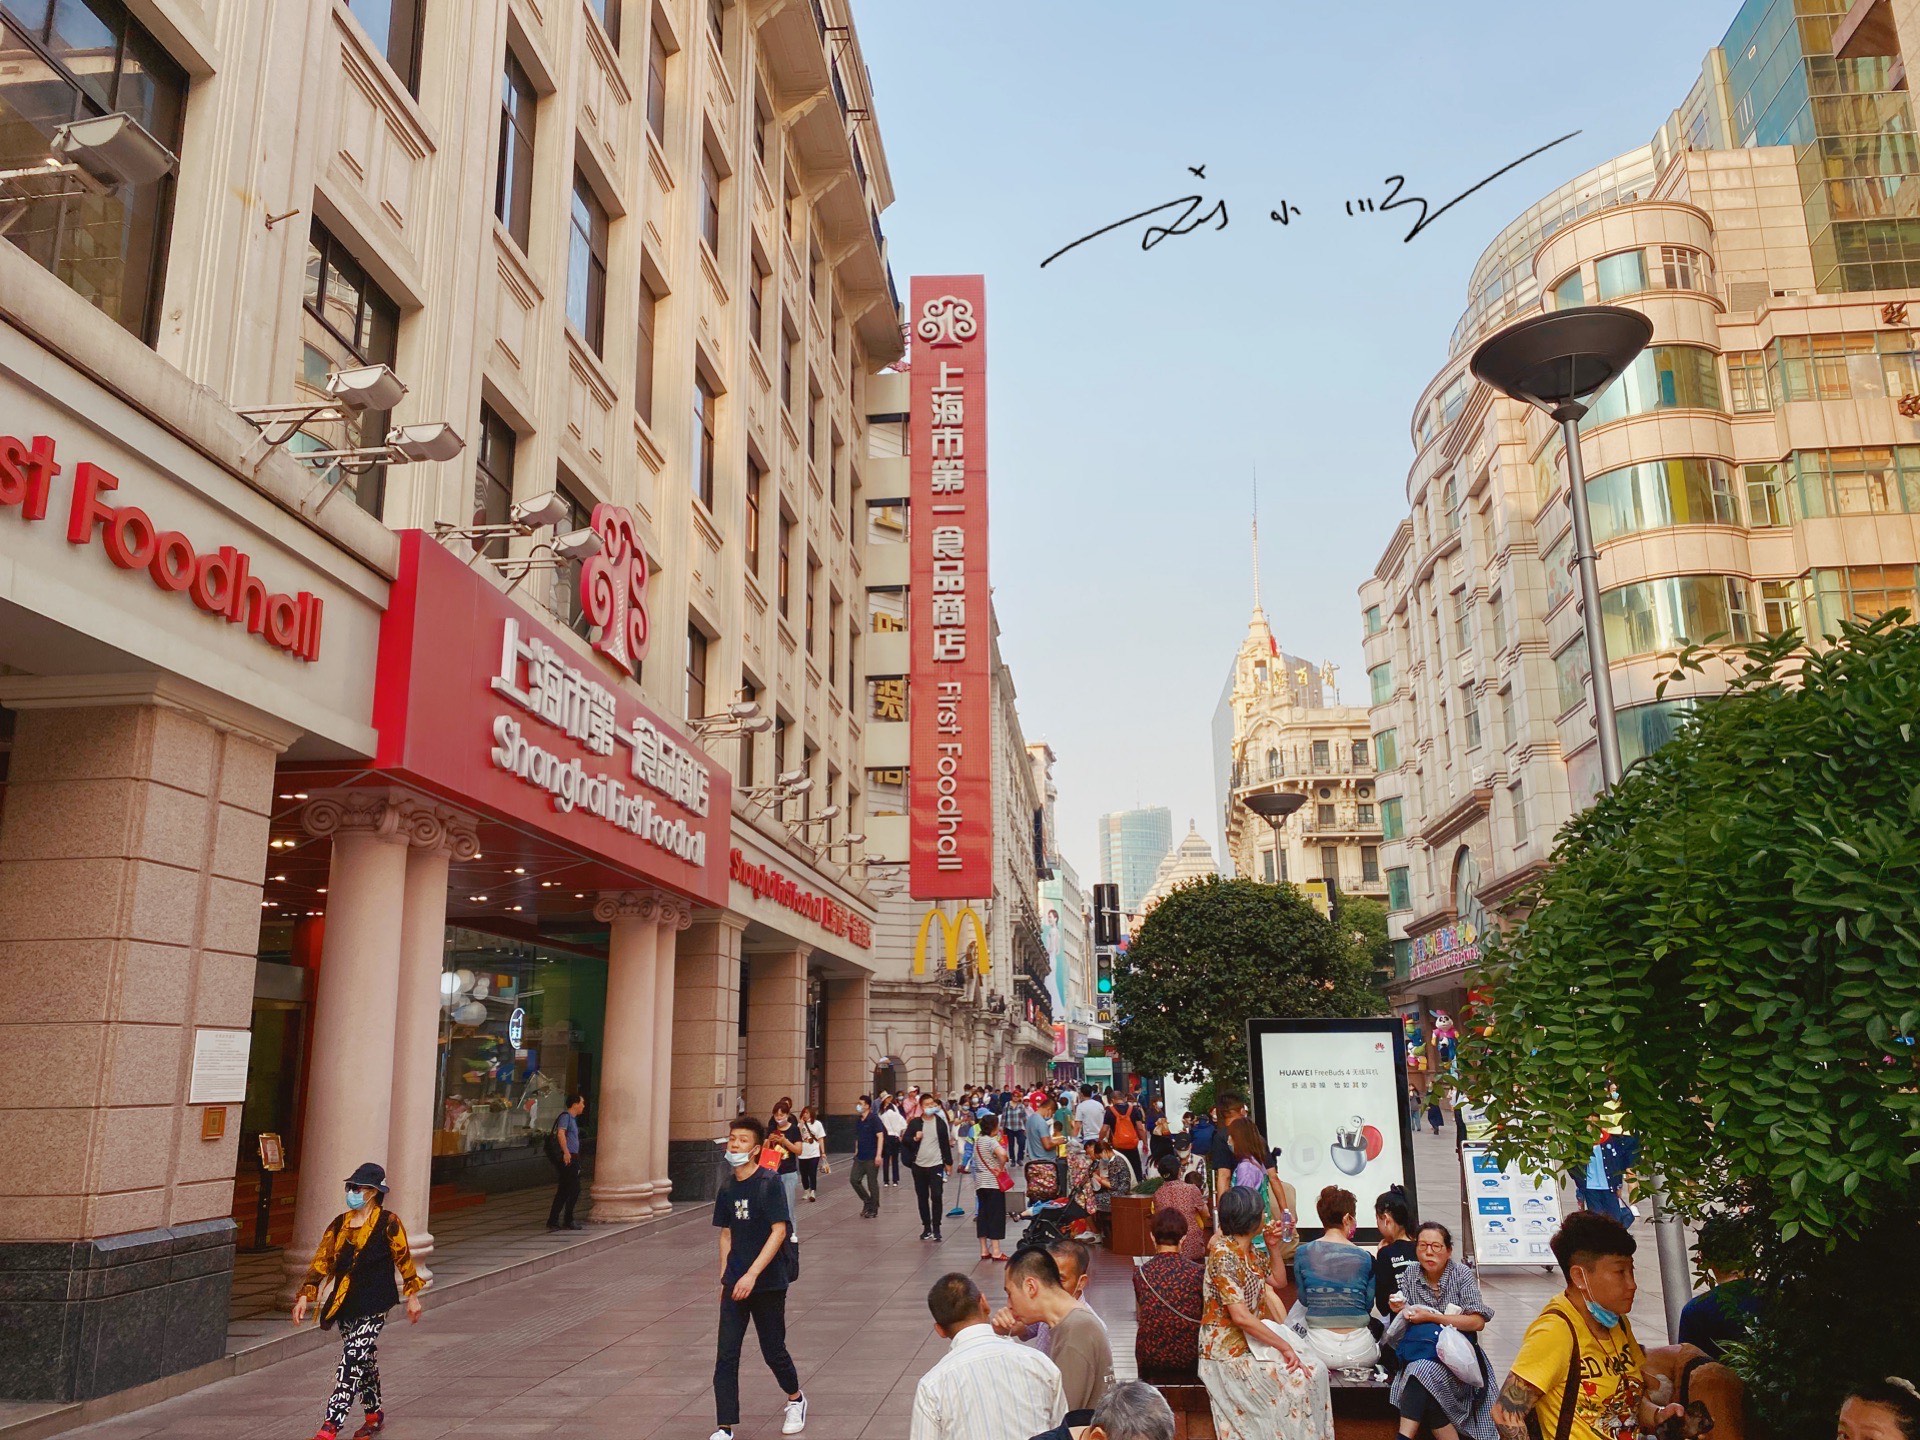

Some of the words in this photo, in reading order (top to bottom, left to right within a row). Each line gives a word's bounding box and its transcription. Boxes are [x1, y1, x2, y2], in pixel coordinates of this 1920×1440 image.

[67, 462, 324, 662] Foodhall
[931, 361, 967, 661] 上海市第一食品商店
[491, 617, 710, 819] 上海市第一食品商店
[937, 681, 962, 736] First
[491, 714, 607, 814] Shanghai
[606, 779, 643, 836] First
[642, 800, 706, 867] Foodhall
[937, 742, 964, 871] Foodhall
[1279, 1069, 1313, 1077] HUAWEI
[1314, 1068, 1345, 1077] FreeBuds
[1352, 1068, 1379, 1076] 无线耳机
